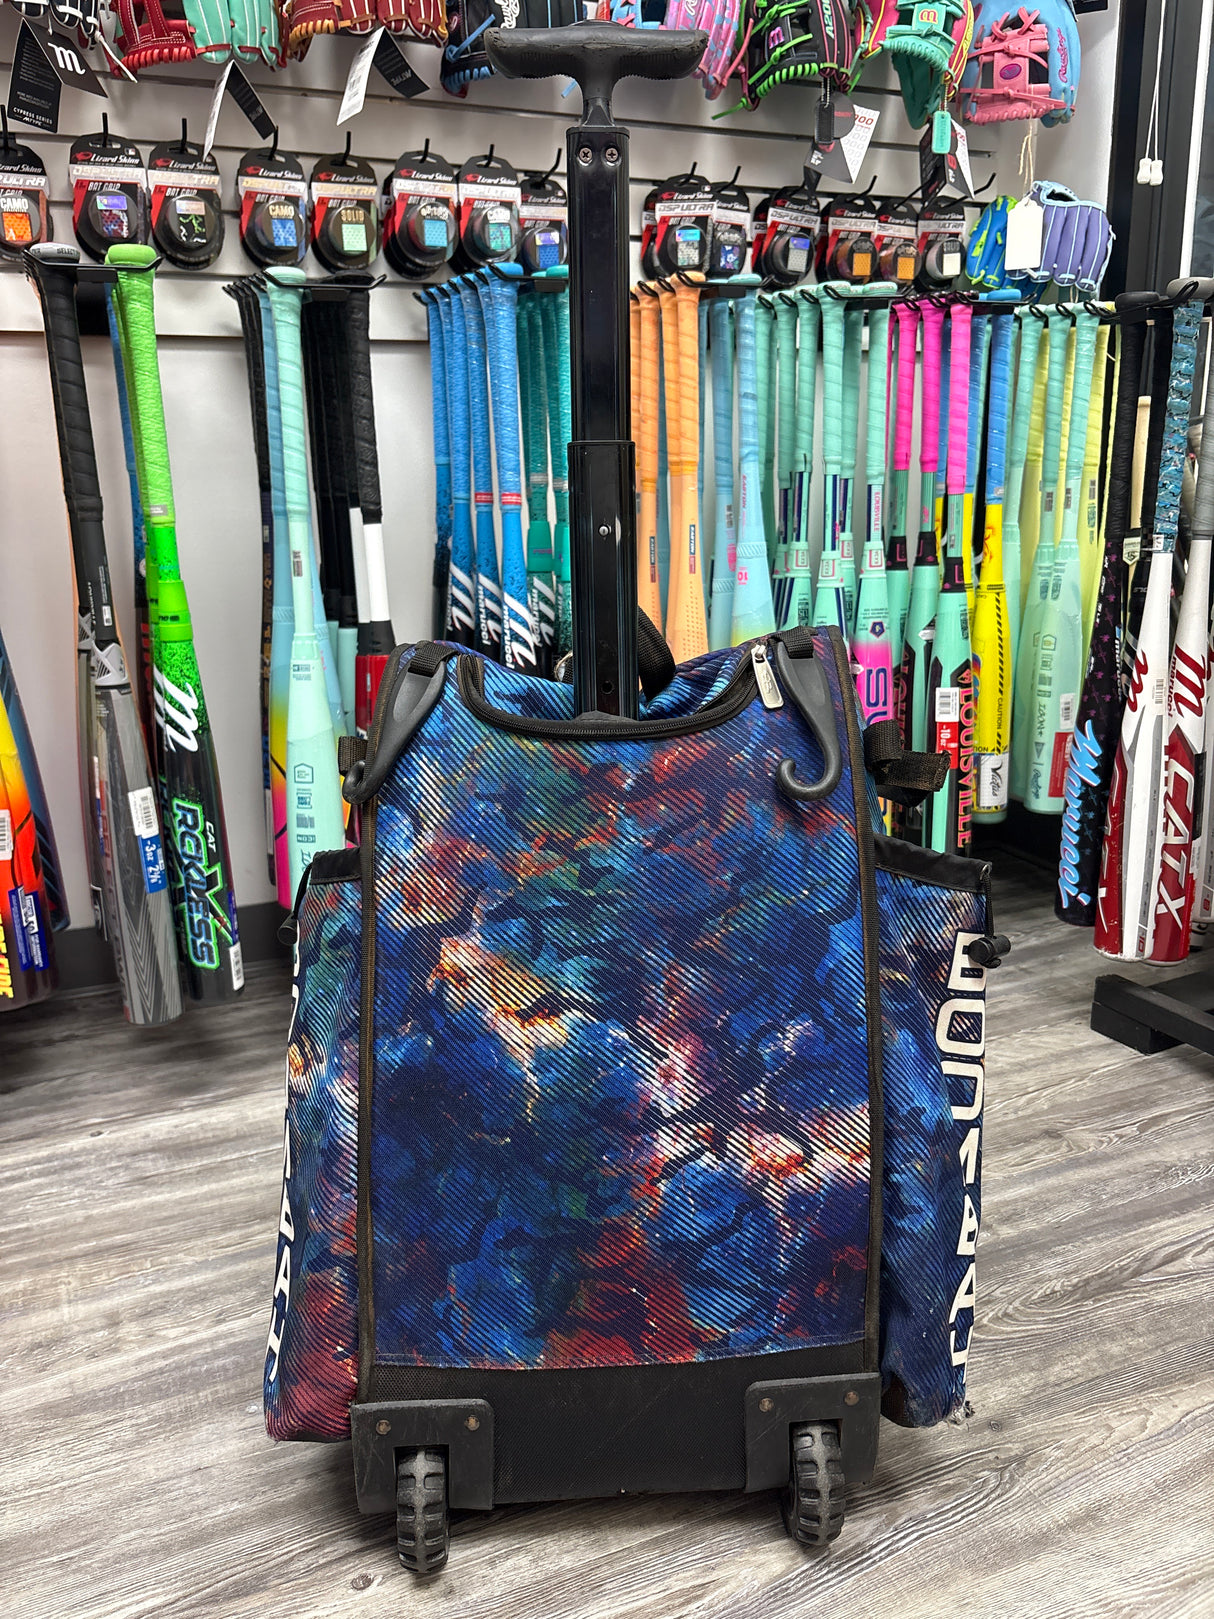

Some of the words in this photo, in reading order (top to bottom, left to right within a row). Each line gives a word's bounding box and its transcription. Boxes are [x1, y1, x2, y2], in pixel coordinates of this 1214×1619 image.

[13, 107, 35, 119] CYPRESS
[35, 114, 53, 125] SERIES
[91, 153, 118, 163] Lizard
[118, 154, 140, 165] Skins
[169, 160, 196, 170] Lizard
[196, 162, 217, 172] Skins
[0, 163, 22, 172] zard
[21, 164, 43, 174] Skins
[259, 168, 284, 178] Lizard
[284, 170, 303, 179] Skins
[411, 171, 435, 180] Lizard
[331, 173, 356, 182] Lizard
[477, 175, 500, 184] Lizard
[0, 197, 29, 210] CAMO
[674, 192, 696, 201] Lizard
[268, 204, 295, 217] CAMO
[658, 204, 680, 212] DSP
[681, 203, 715, 211] ULTRA
[340, 208, 365, 222] SOLID
[770, 210, 791, 220] DSP
[790, 212, 818, 226] ULTRA
[873, 491, 881, 532] LOUISVILLE
[477, 585, 491, 646] marucci
[502, 605, 515, 670] marucci
[1167, 654, 1176, 718] marucci
[996, 697, 1004, 730] CAUTION
[957, 686, 973, 849] LOUISVILLE
[990, 760, 1003, 797] Victus
[1061, 719, 1103, 909] Marucci
[1157, 757, 1196, 931] CATX
